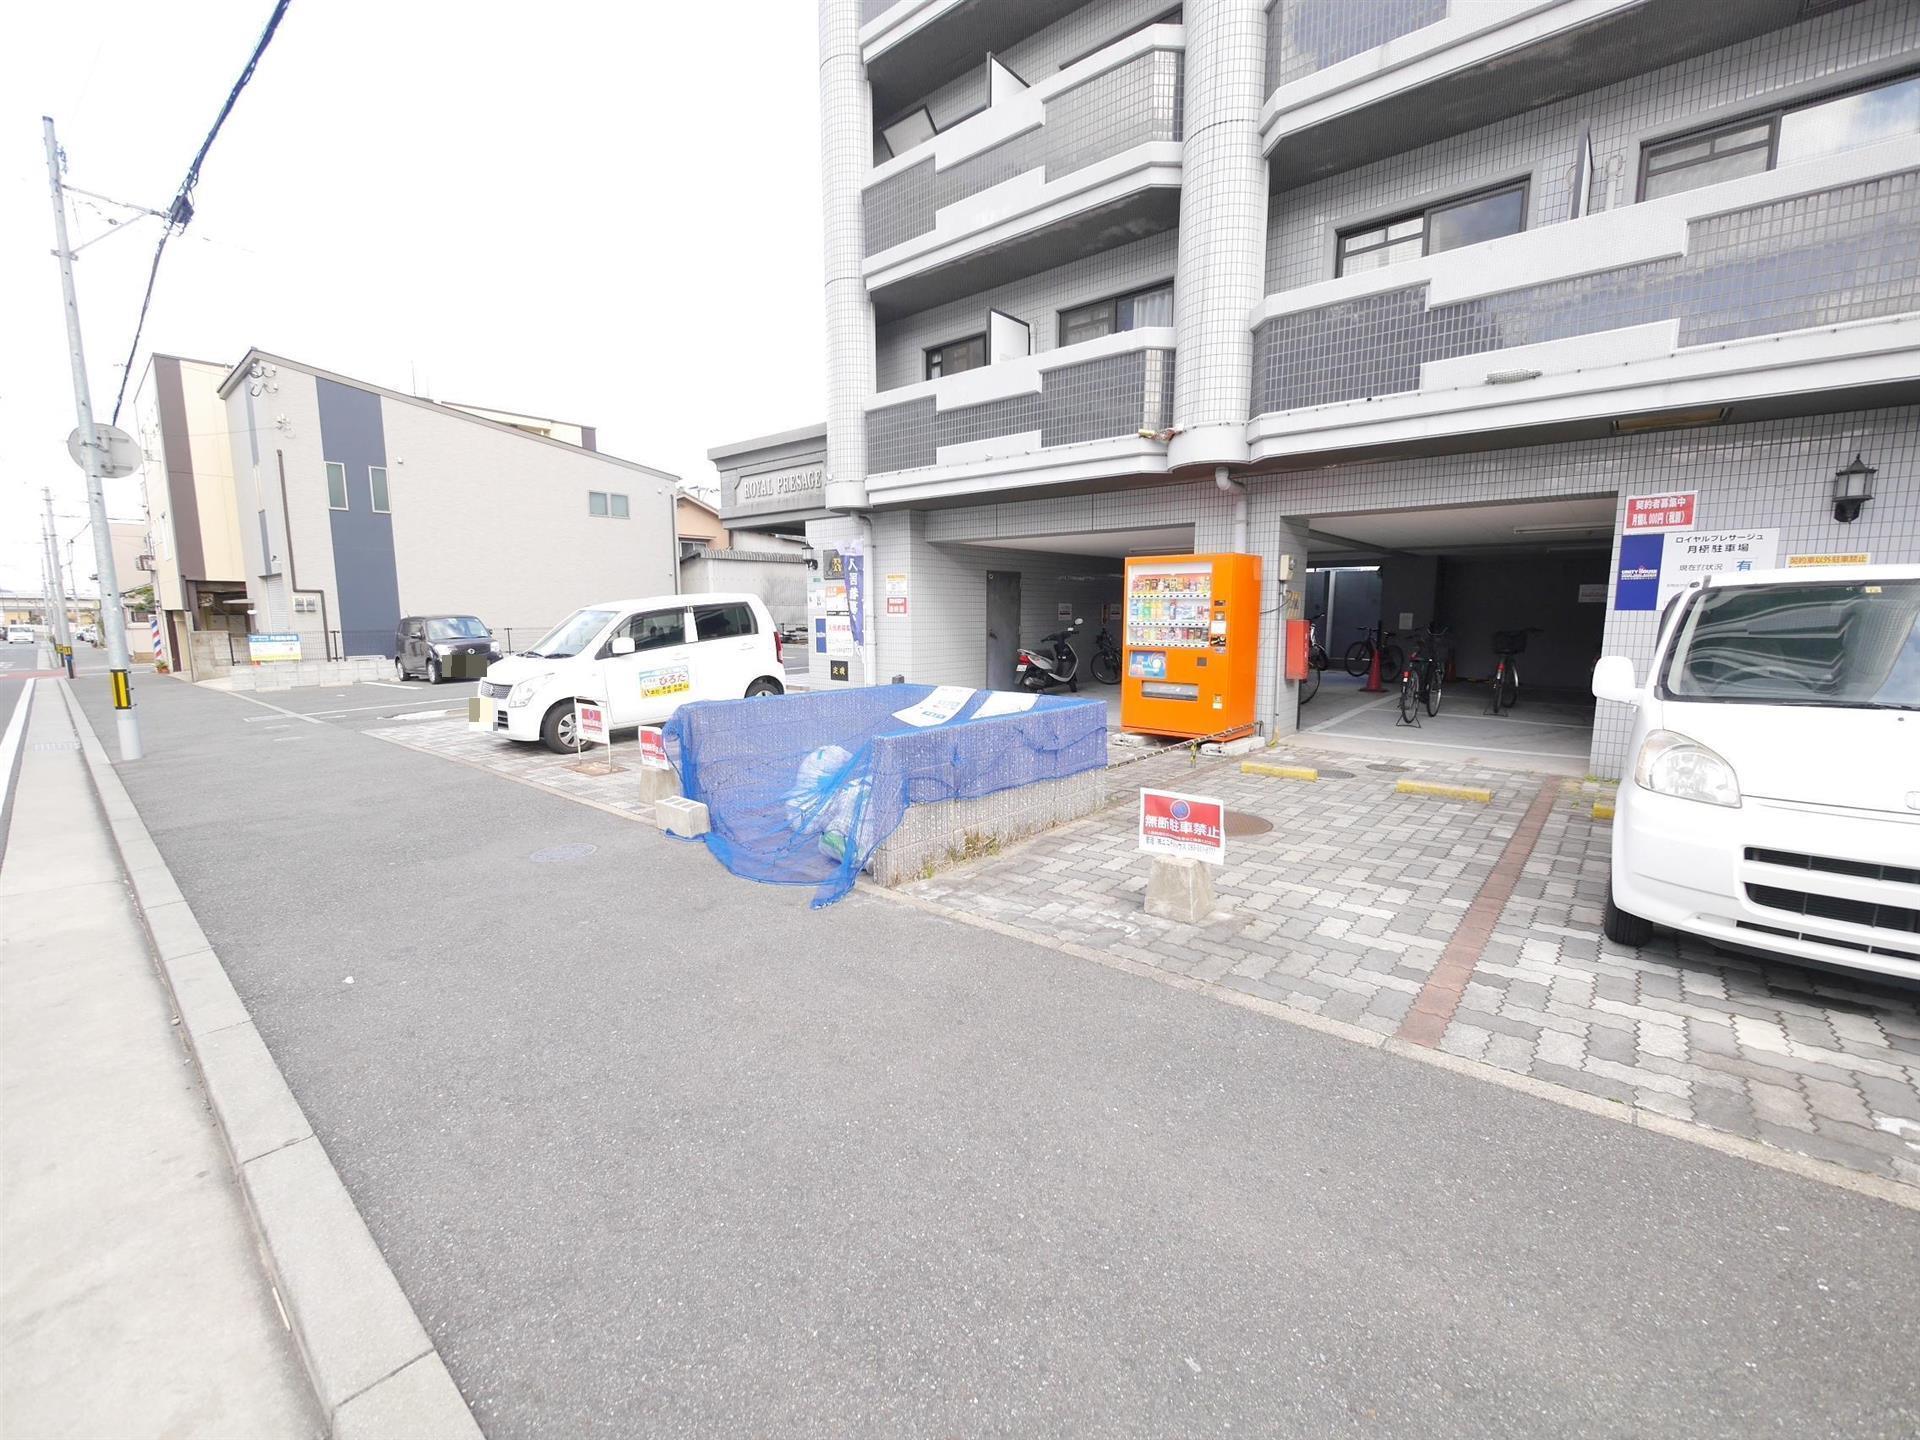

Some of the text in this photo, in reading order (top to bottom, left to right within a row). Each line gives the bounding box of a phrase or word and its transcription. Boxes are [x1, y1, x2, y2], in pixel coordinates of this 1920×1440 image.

[744, 469, 822, 498] ROYAL PRESAGE
[1635, 497, 1686, 511] 契約者募集中
[1675, 533, 1764, 544] ロイヤルプレサージュ
[1687, 543, 1749, 554] 月極駐車場
[1736, 560, 1752, 572] 有
[658, 674, 687, 686] ひろた
[1145, 814, 1221, 839] 無断駐車禁止
